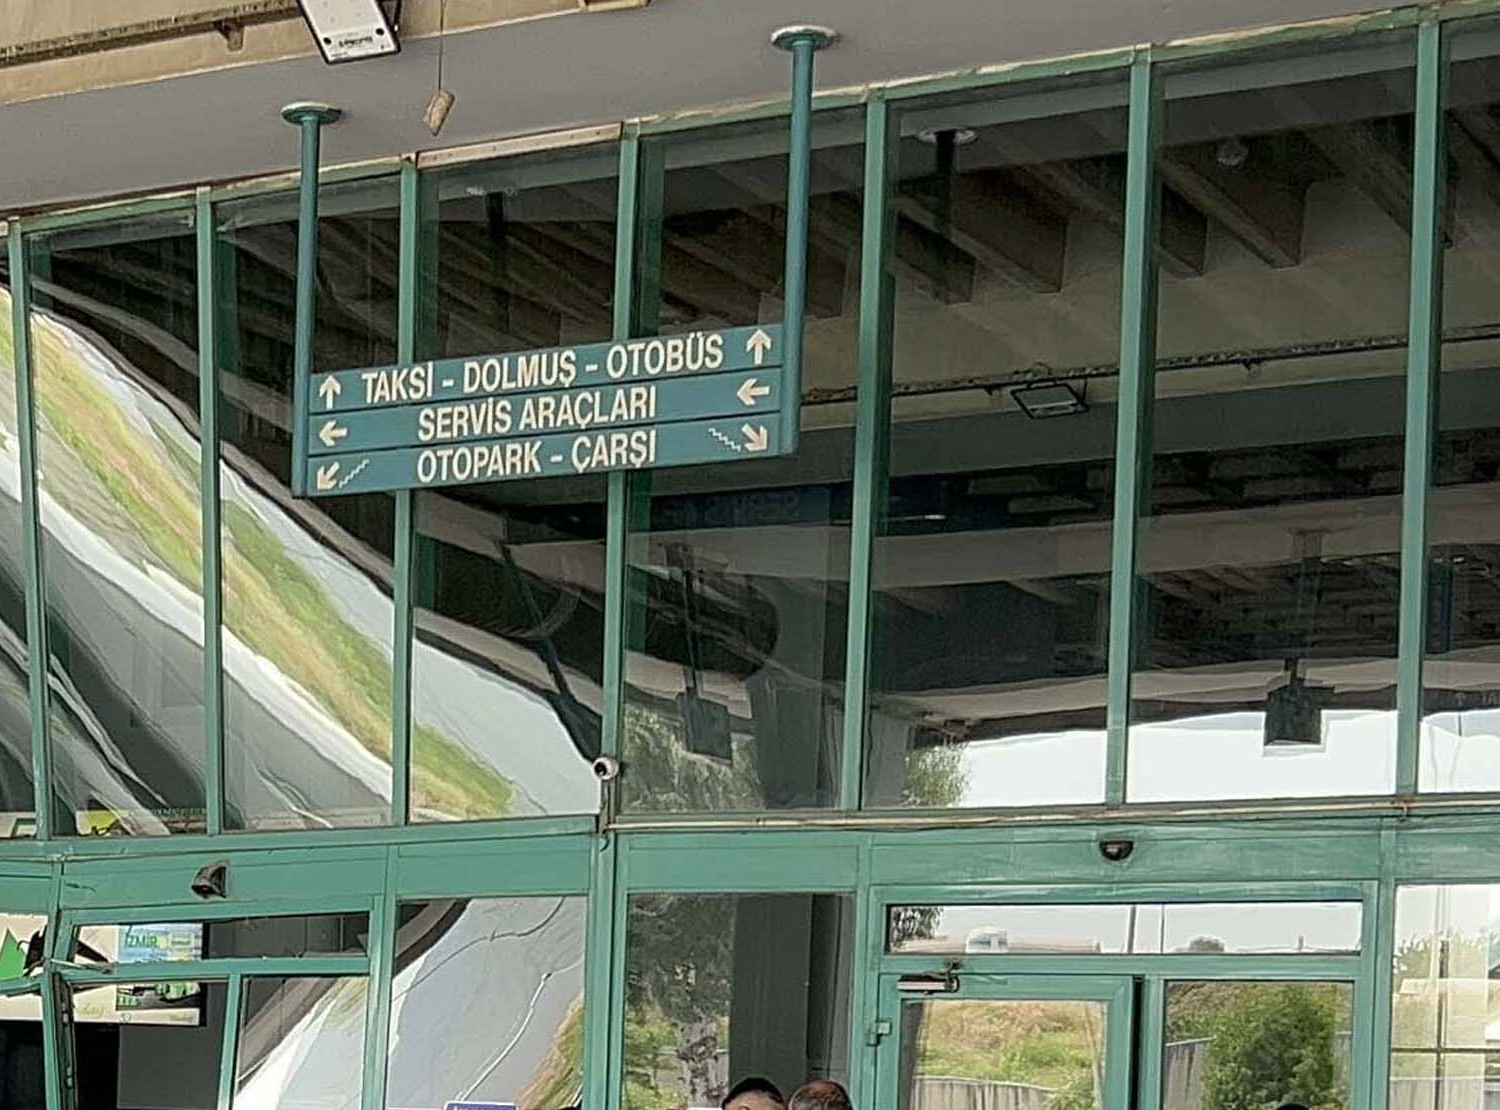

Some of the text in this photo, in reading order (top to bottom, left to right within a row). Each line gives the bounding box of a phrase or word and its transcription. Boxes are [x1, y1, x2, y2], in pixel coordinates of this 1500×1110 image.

[361, 360, 434, 404] TAKSİ
[463, 350, 577, 394] DOLMUŞ
[606, 331, 724, 379] OTOBÜS
[417, 385, 656, 442] SERVİS ARAÇLARI
[416, 440, 542, 484] OTOPARK
[571, 429, 657, 474] ÇARŞI
